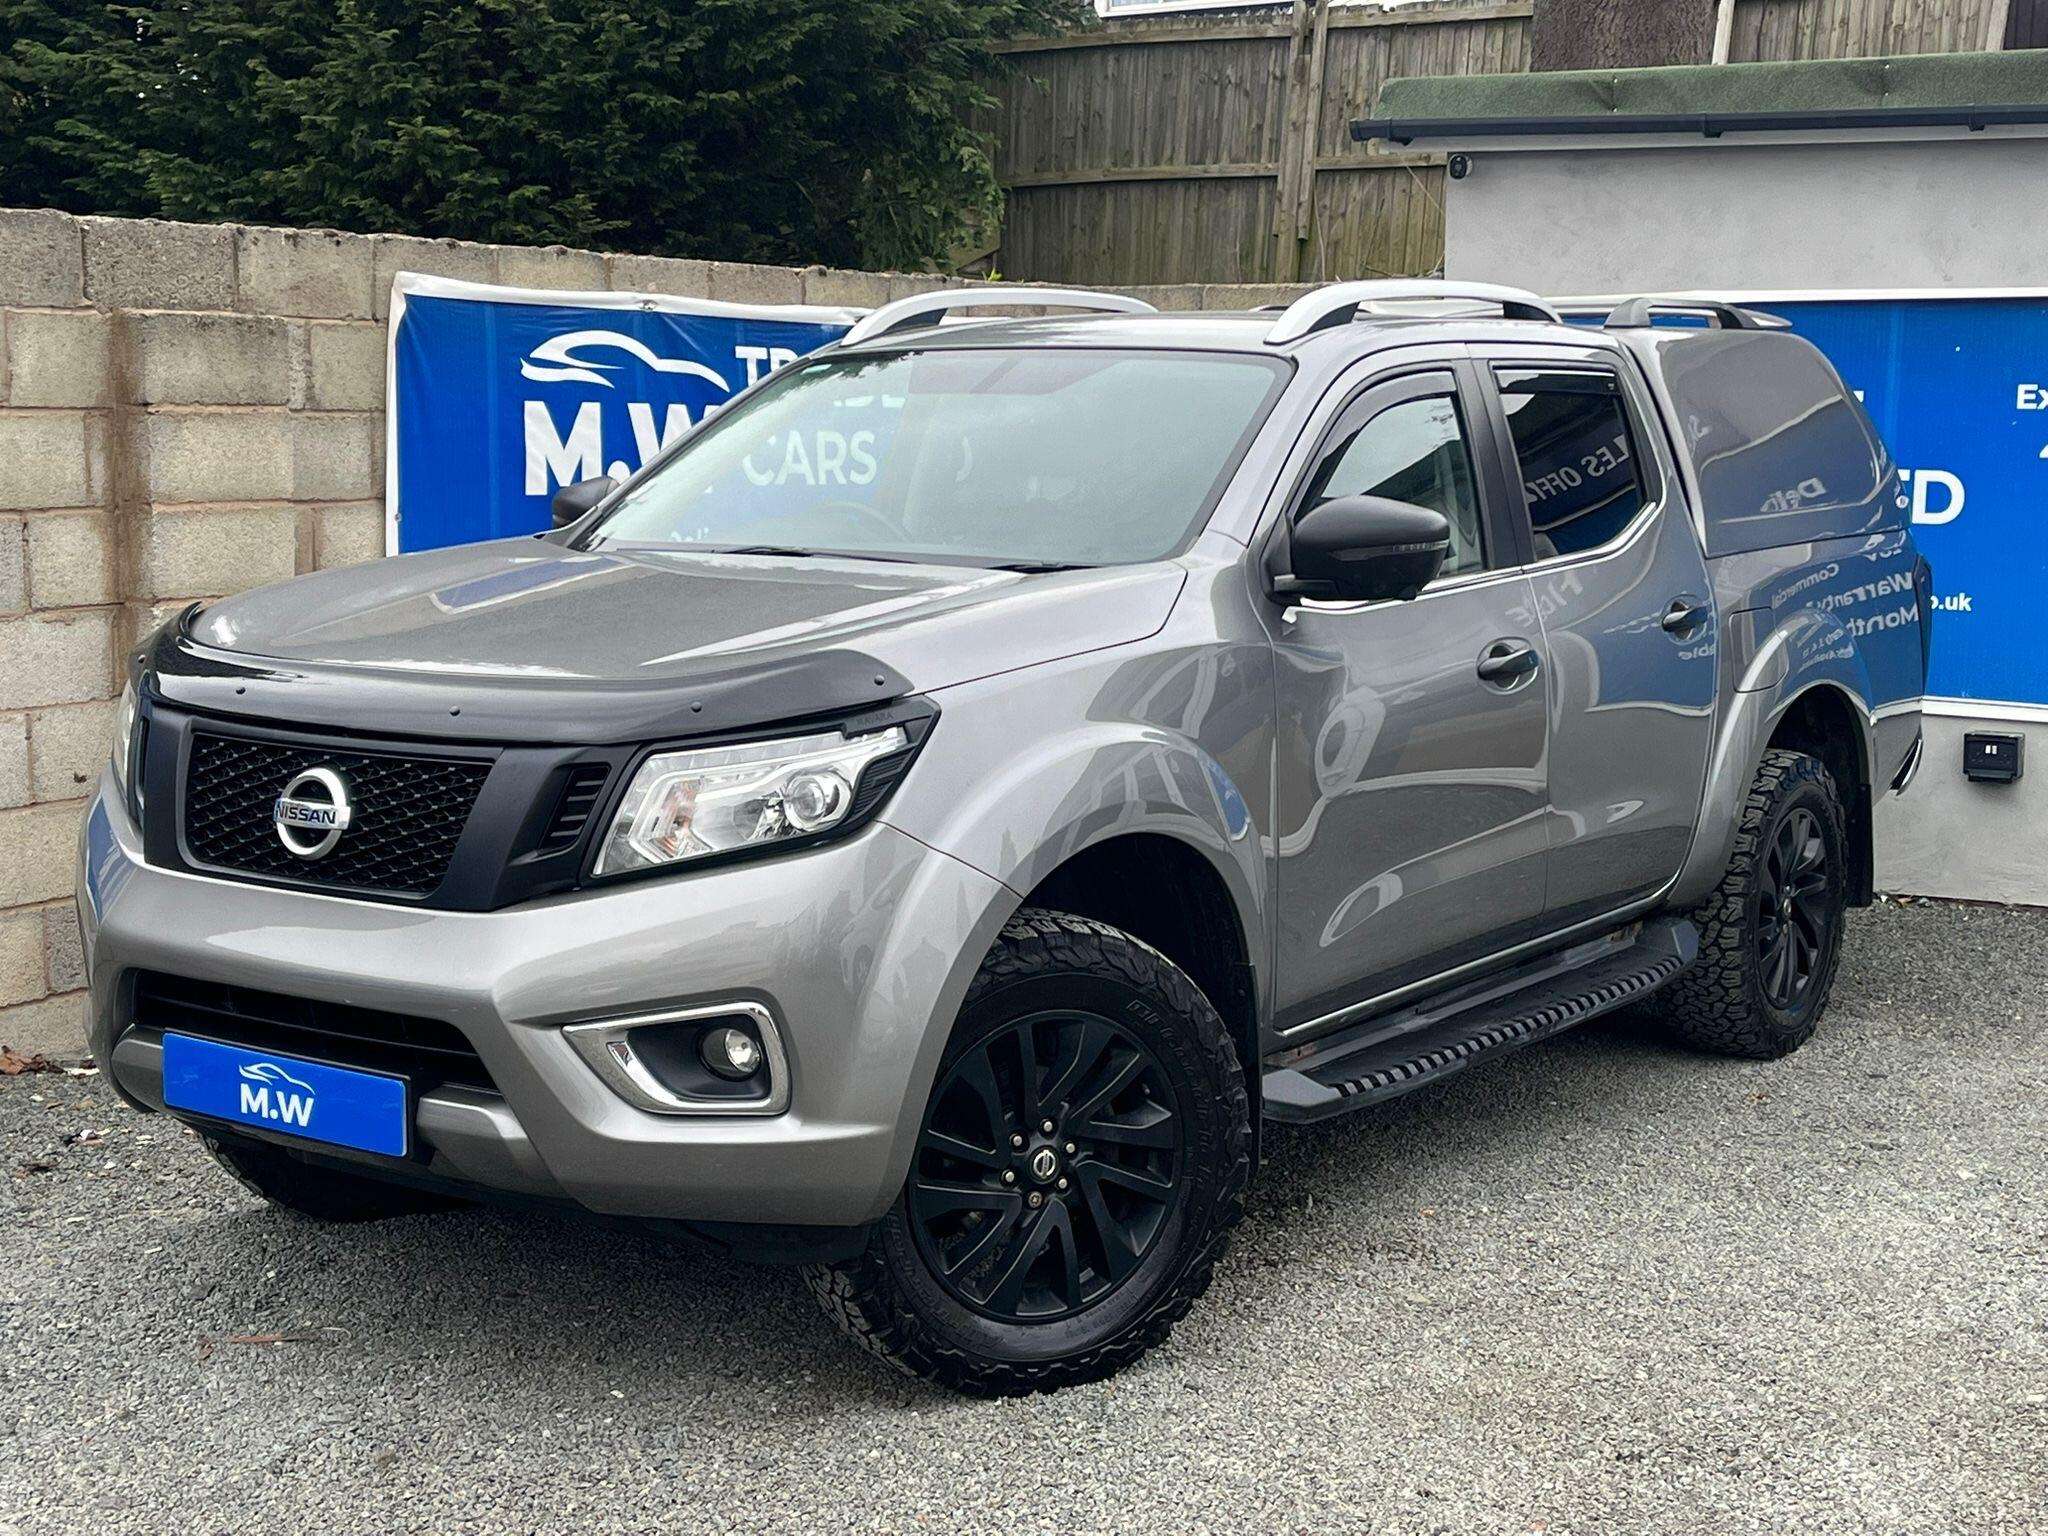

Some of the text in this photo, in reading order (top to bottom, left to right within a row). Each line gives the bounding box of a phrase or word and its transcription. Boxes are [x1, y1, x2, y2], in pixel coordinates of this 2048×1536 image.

[742, 430, 877, 486] CARS
[275, 801, 336, 824] NISSAN
[240, 1083, 314, 1127] M.W
